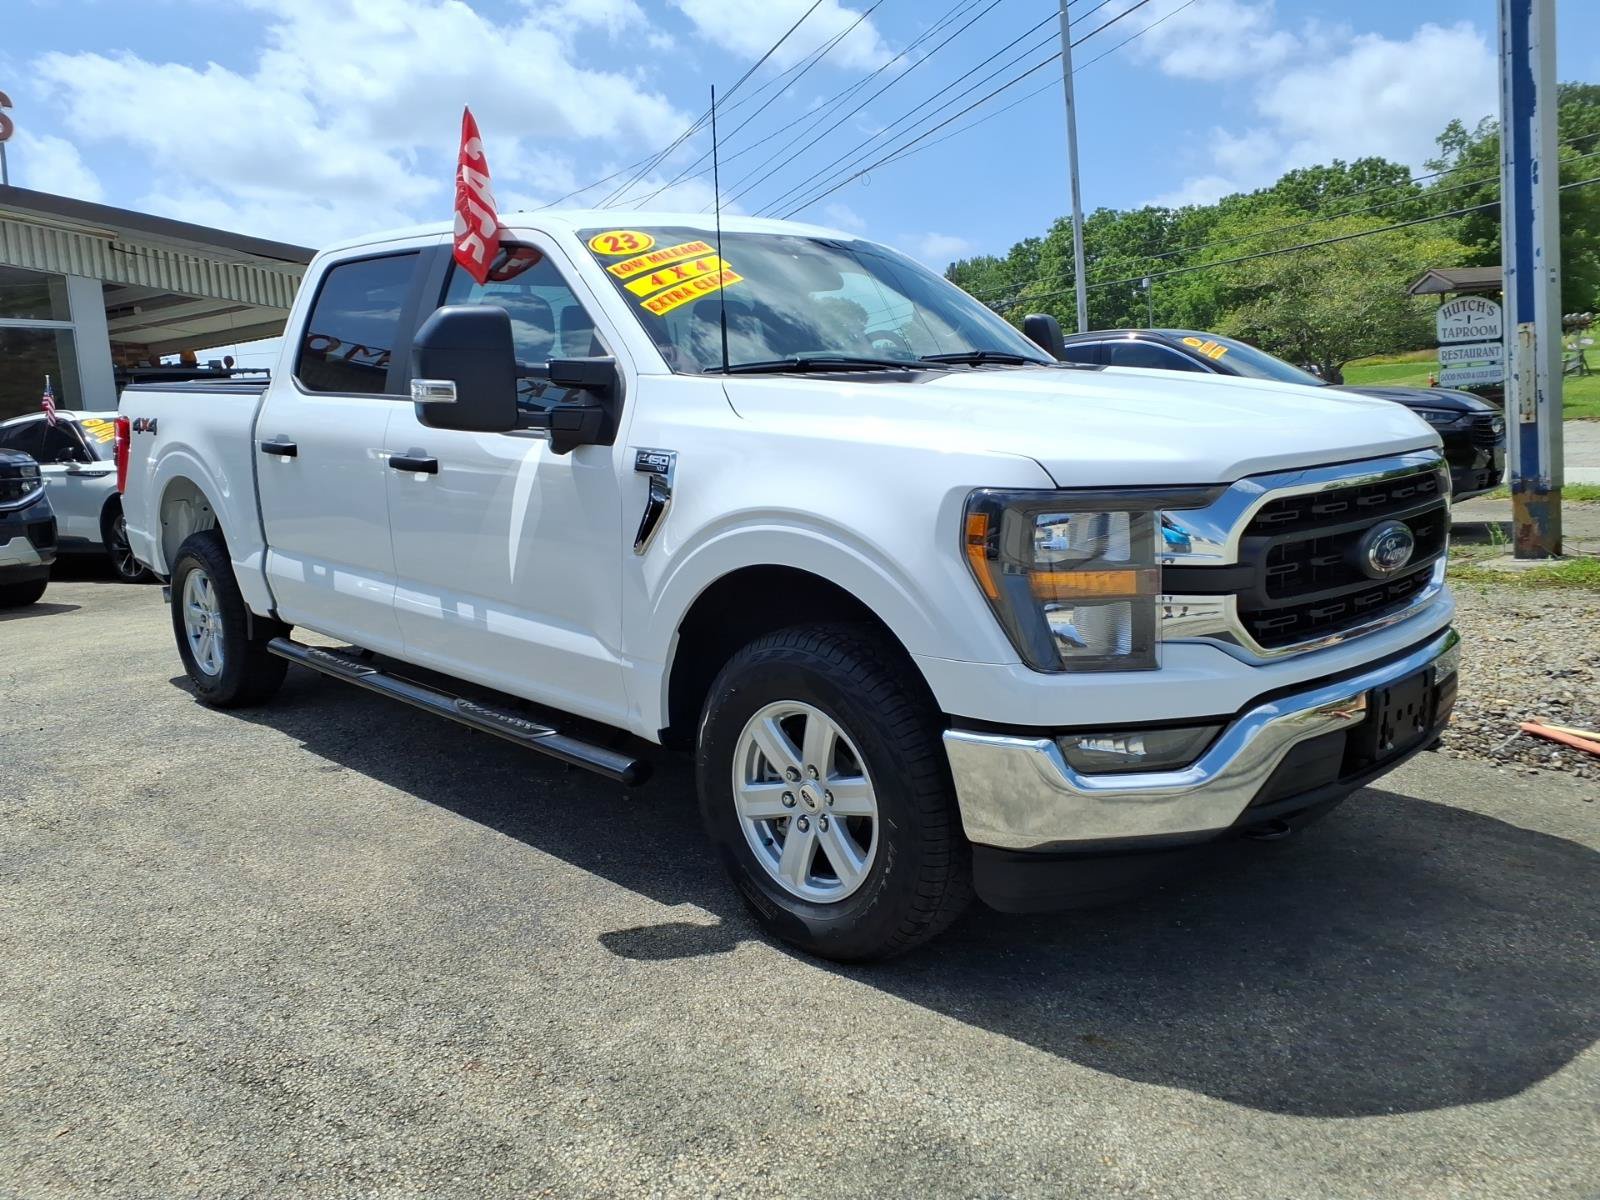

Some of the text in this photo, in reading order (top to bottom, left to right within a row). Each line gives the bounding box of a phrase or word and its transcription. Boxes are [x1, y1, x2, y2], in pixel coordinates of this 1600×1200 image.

[603, 232, 640, 252] 23
[612, 242, 709, 275] LOW MILEAGE
[651, 274, 665, 286] 4
[696, 260, 709, 272] 4
[646, 286, 695, 311] EXTRA
[1442, 299, 1496, 320] HUTCH'S
[1441, 324, 1498, 339] TAPROOM
[1441, 346, 1501, 361] RESTAURANT
